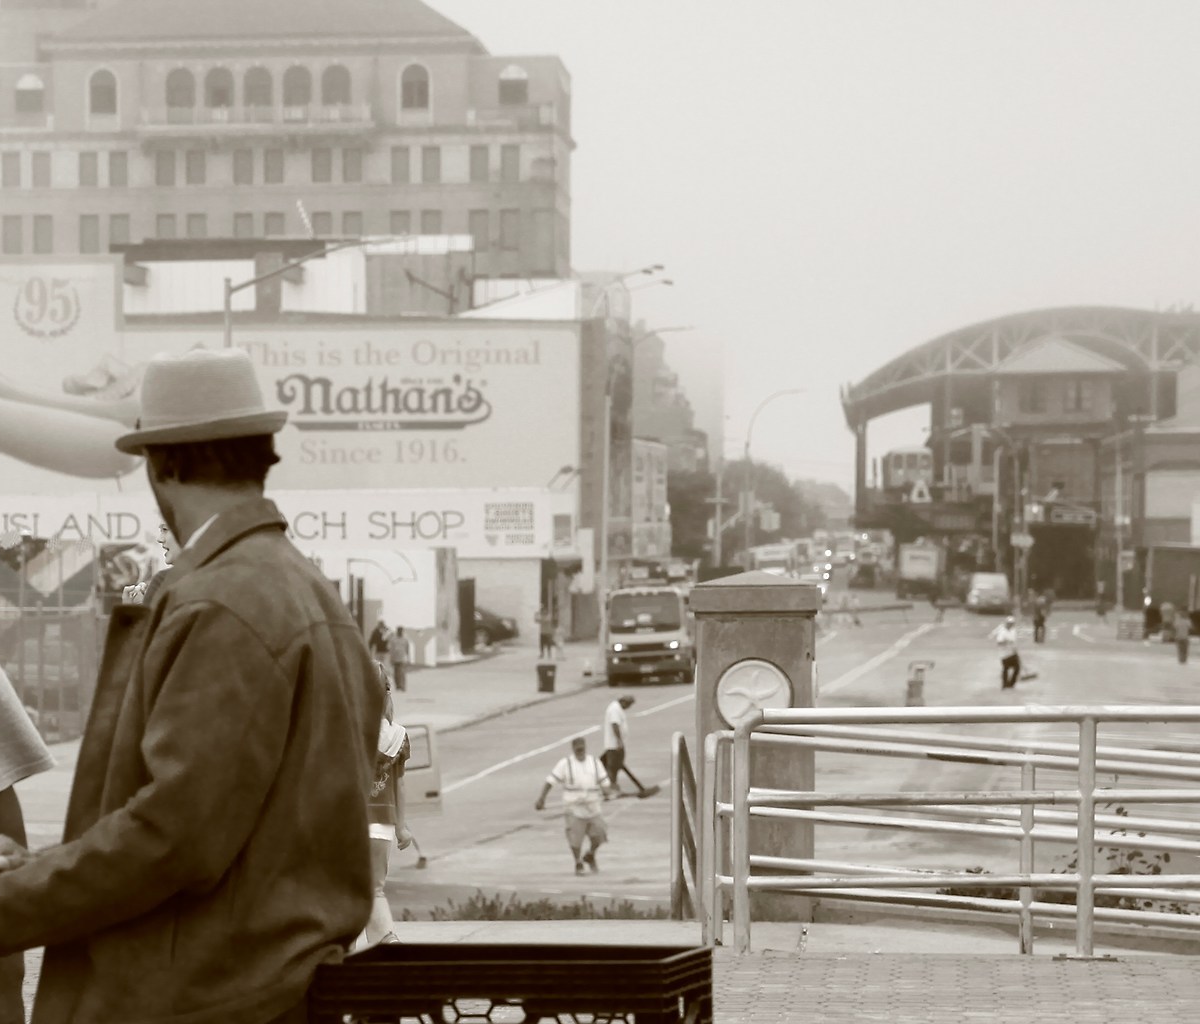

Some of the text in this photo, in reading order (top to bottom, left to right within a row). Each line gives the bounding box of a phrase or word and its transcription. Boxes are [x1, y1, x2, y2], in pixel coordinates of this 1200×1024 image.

[24, 277, 73, 324] 95
[237, 339, 542, 373] This is the Original
[275, 373, 492, 426] Nathan's
[300, 438, 467, 464] Since 1916.
[367, 510, 465, 540] SHOP
